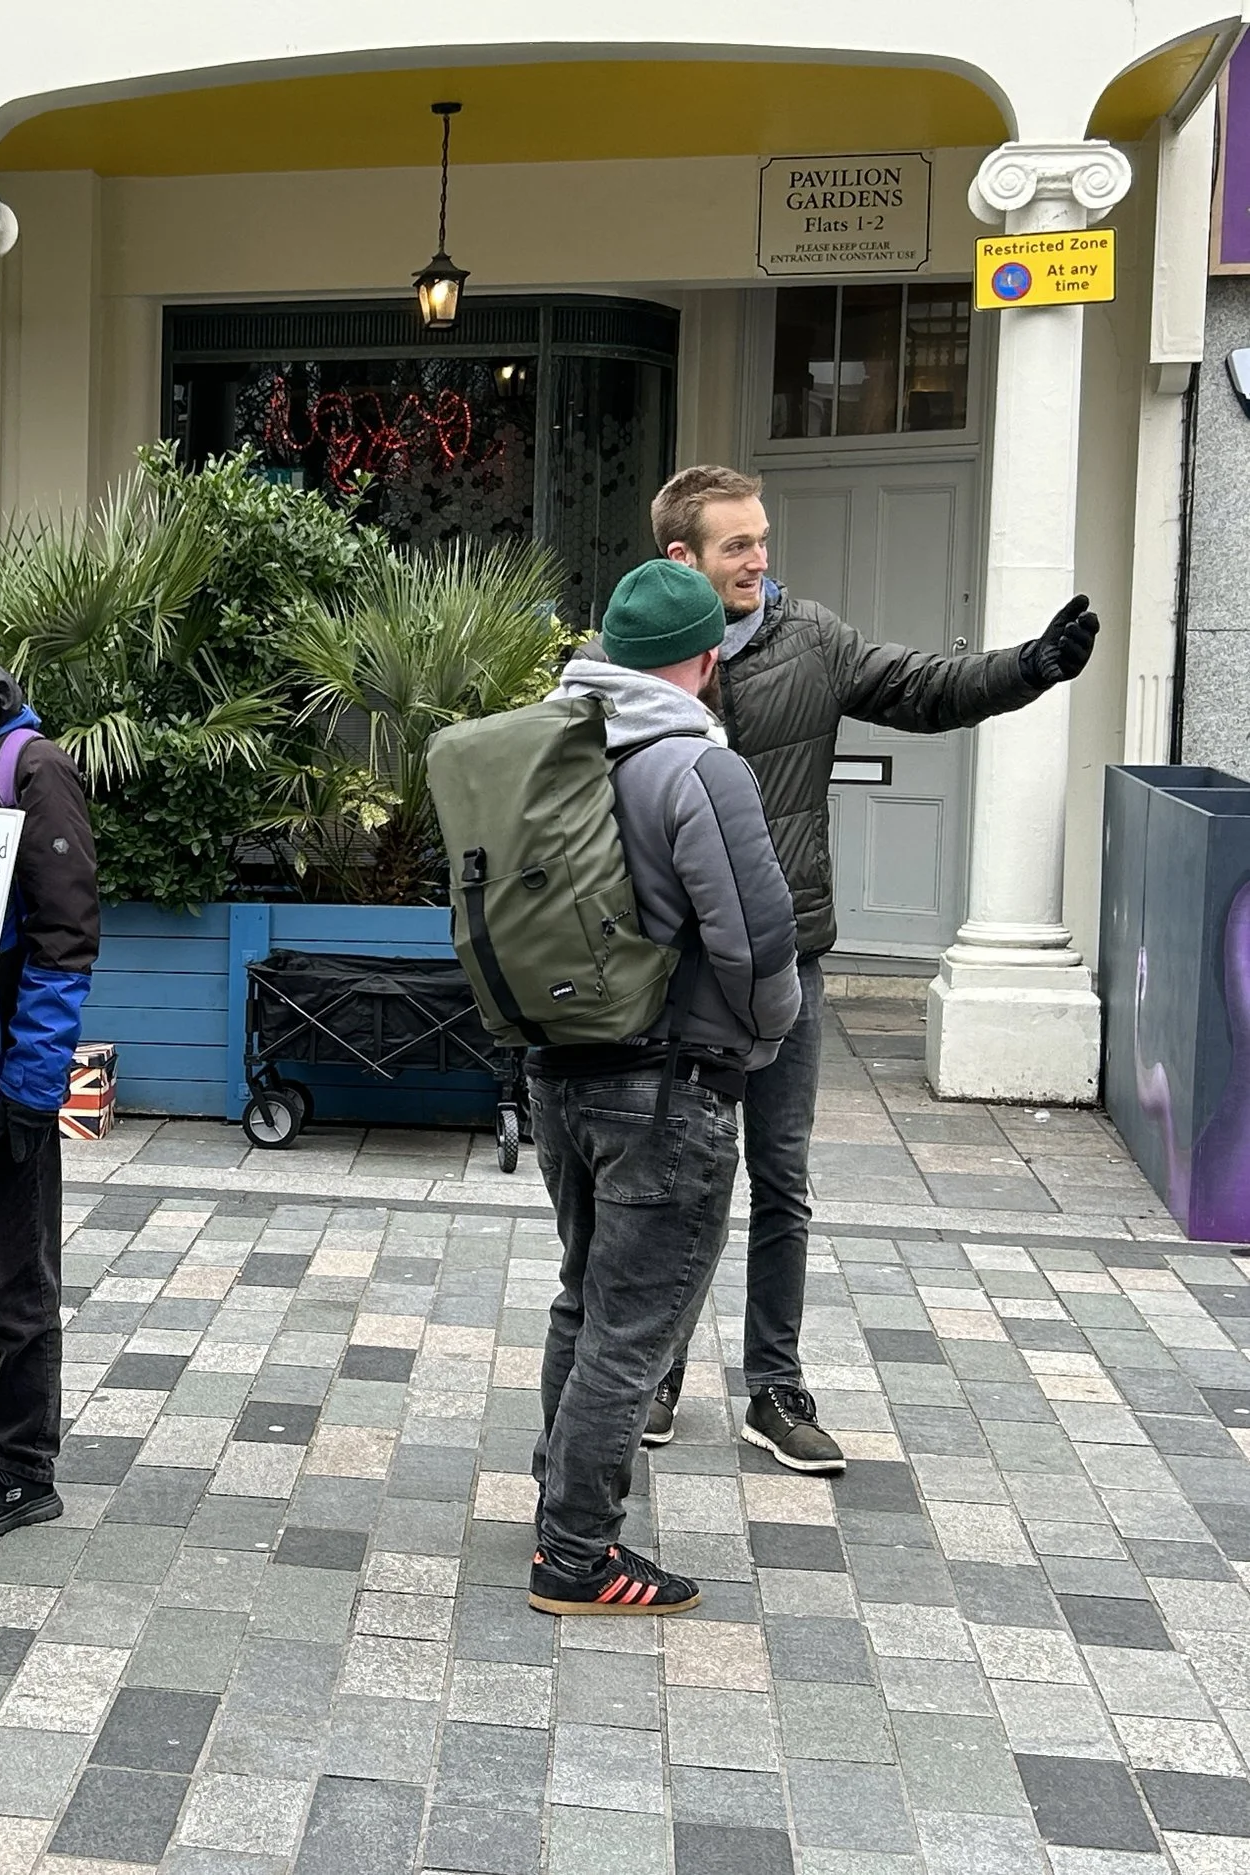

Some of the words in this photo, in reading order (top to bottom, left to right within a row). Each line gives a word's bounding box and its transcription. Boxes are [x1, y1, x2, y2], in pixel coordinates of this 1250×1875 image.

[789, 167, 902, 189] PAVILION
[786, 189, 903, 211] GARDENS
[804, 216, 849, 233] Flats
[857, 215, 884, 231] 1-2
[795, 243, 831, 253] PLEASE
[832, 242, 857, 251] KEEP
[859, 241, 890, 251] CLEAR
[983, 240, 1065, 256] Restricted
[1070, 238, 1108, 251] Zone
[770, 253, 824, 264] ENTRANCE
[825, 253, 837, 262] IN
[839, 251, 895, 262] CONSTANT
[897, 250, 916, 260] USE
[1047, 264, 1065, 277] At
[1070, 264, 1098, 277] any
[1055, 279, 1090, 292] time
